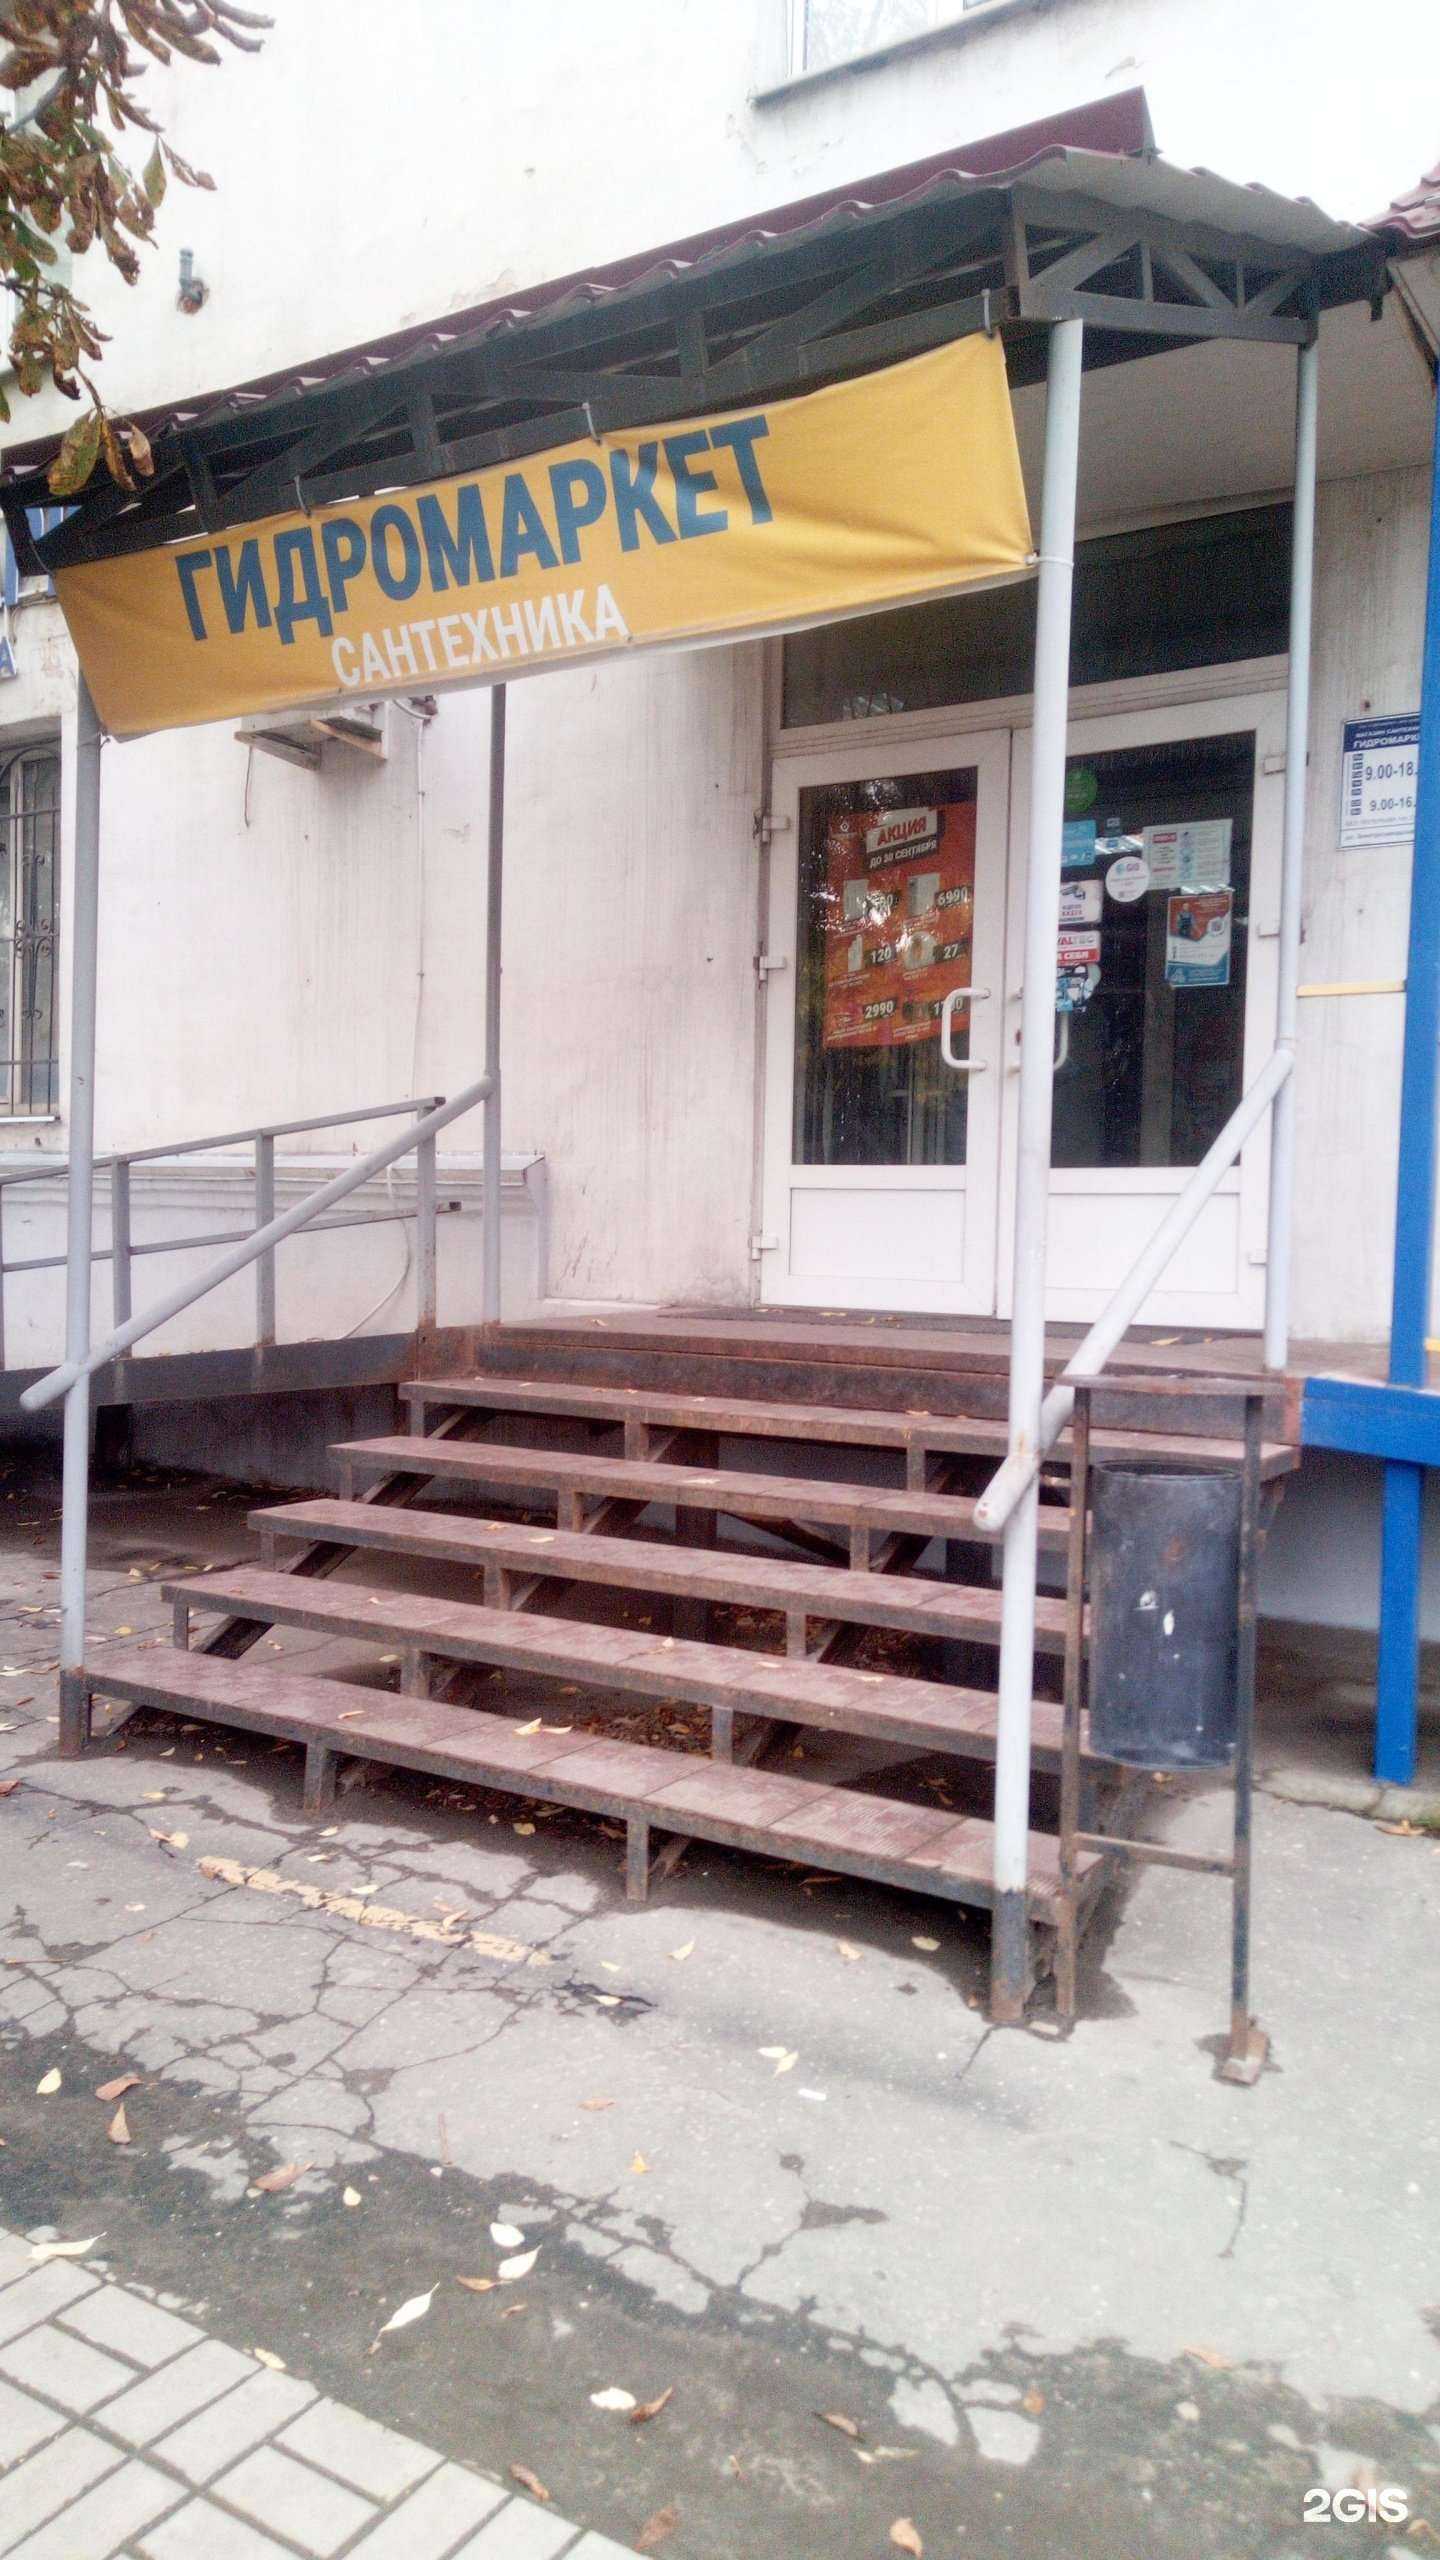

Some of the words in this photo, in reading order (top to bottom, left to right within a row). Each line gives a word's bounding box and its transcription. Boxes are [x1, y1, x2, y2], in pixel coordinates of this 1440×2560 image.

[174, 414, 774, 645] ГИДРОМАРКЕТ
[330, 584, 630, 687] САНТЕХНИКА
[877, 815, 927, 847] АКЦИЯ
[869, 855, 882, 869] ДО
[895, 839, 937, 860] СЕНТЯБРЯ
[938, 887, 968, 905] 6990
[871, 947, 892, 964] 120
[865, 1001, 894, 1019] 2990
